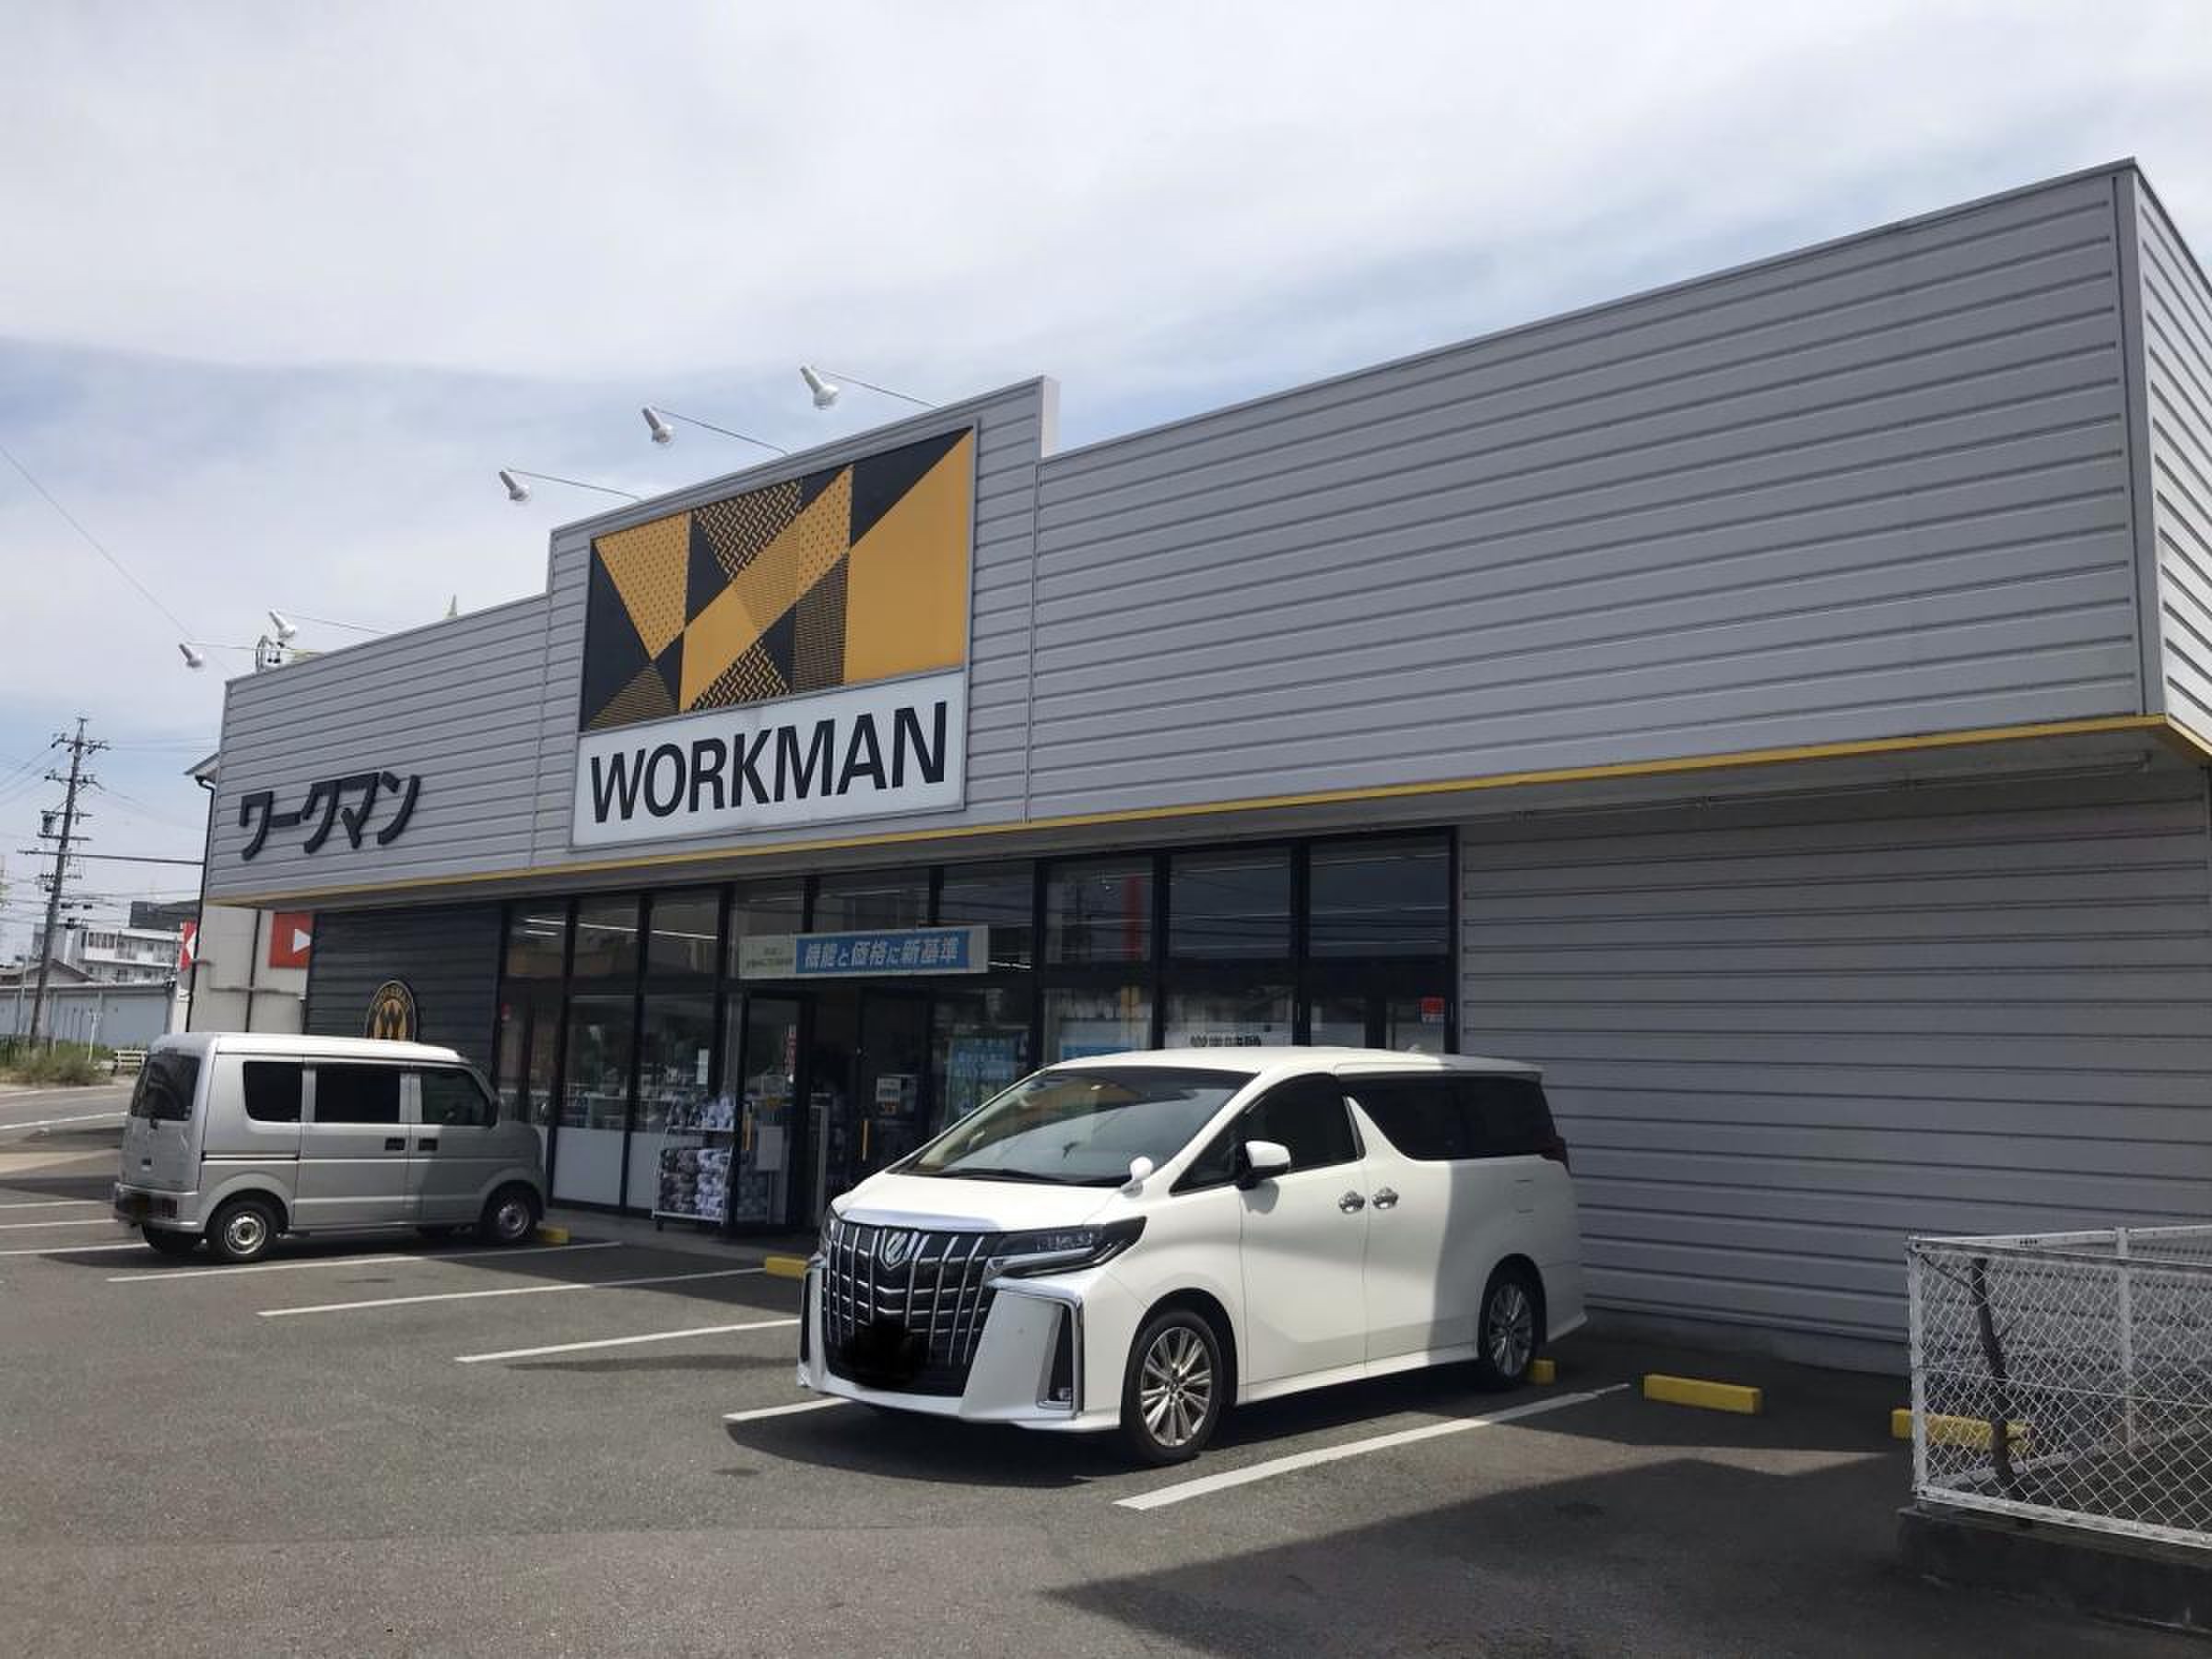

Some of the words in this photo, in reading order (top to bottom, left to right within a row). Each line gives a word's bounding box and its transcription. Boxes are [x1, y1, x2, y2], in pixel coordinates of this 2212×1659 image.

[591, 701, 947, 823] WORKMAN
[240, 771, 421, 861] ワークマン
